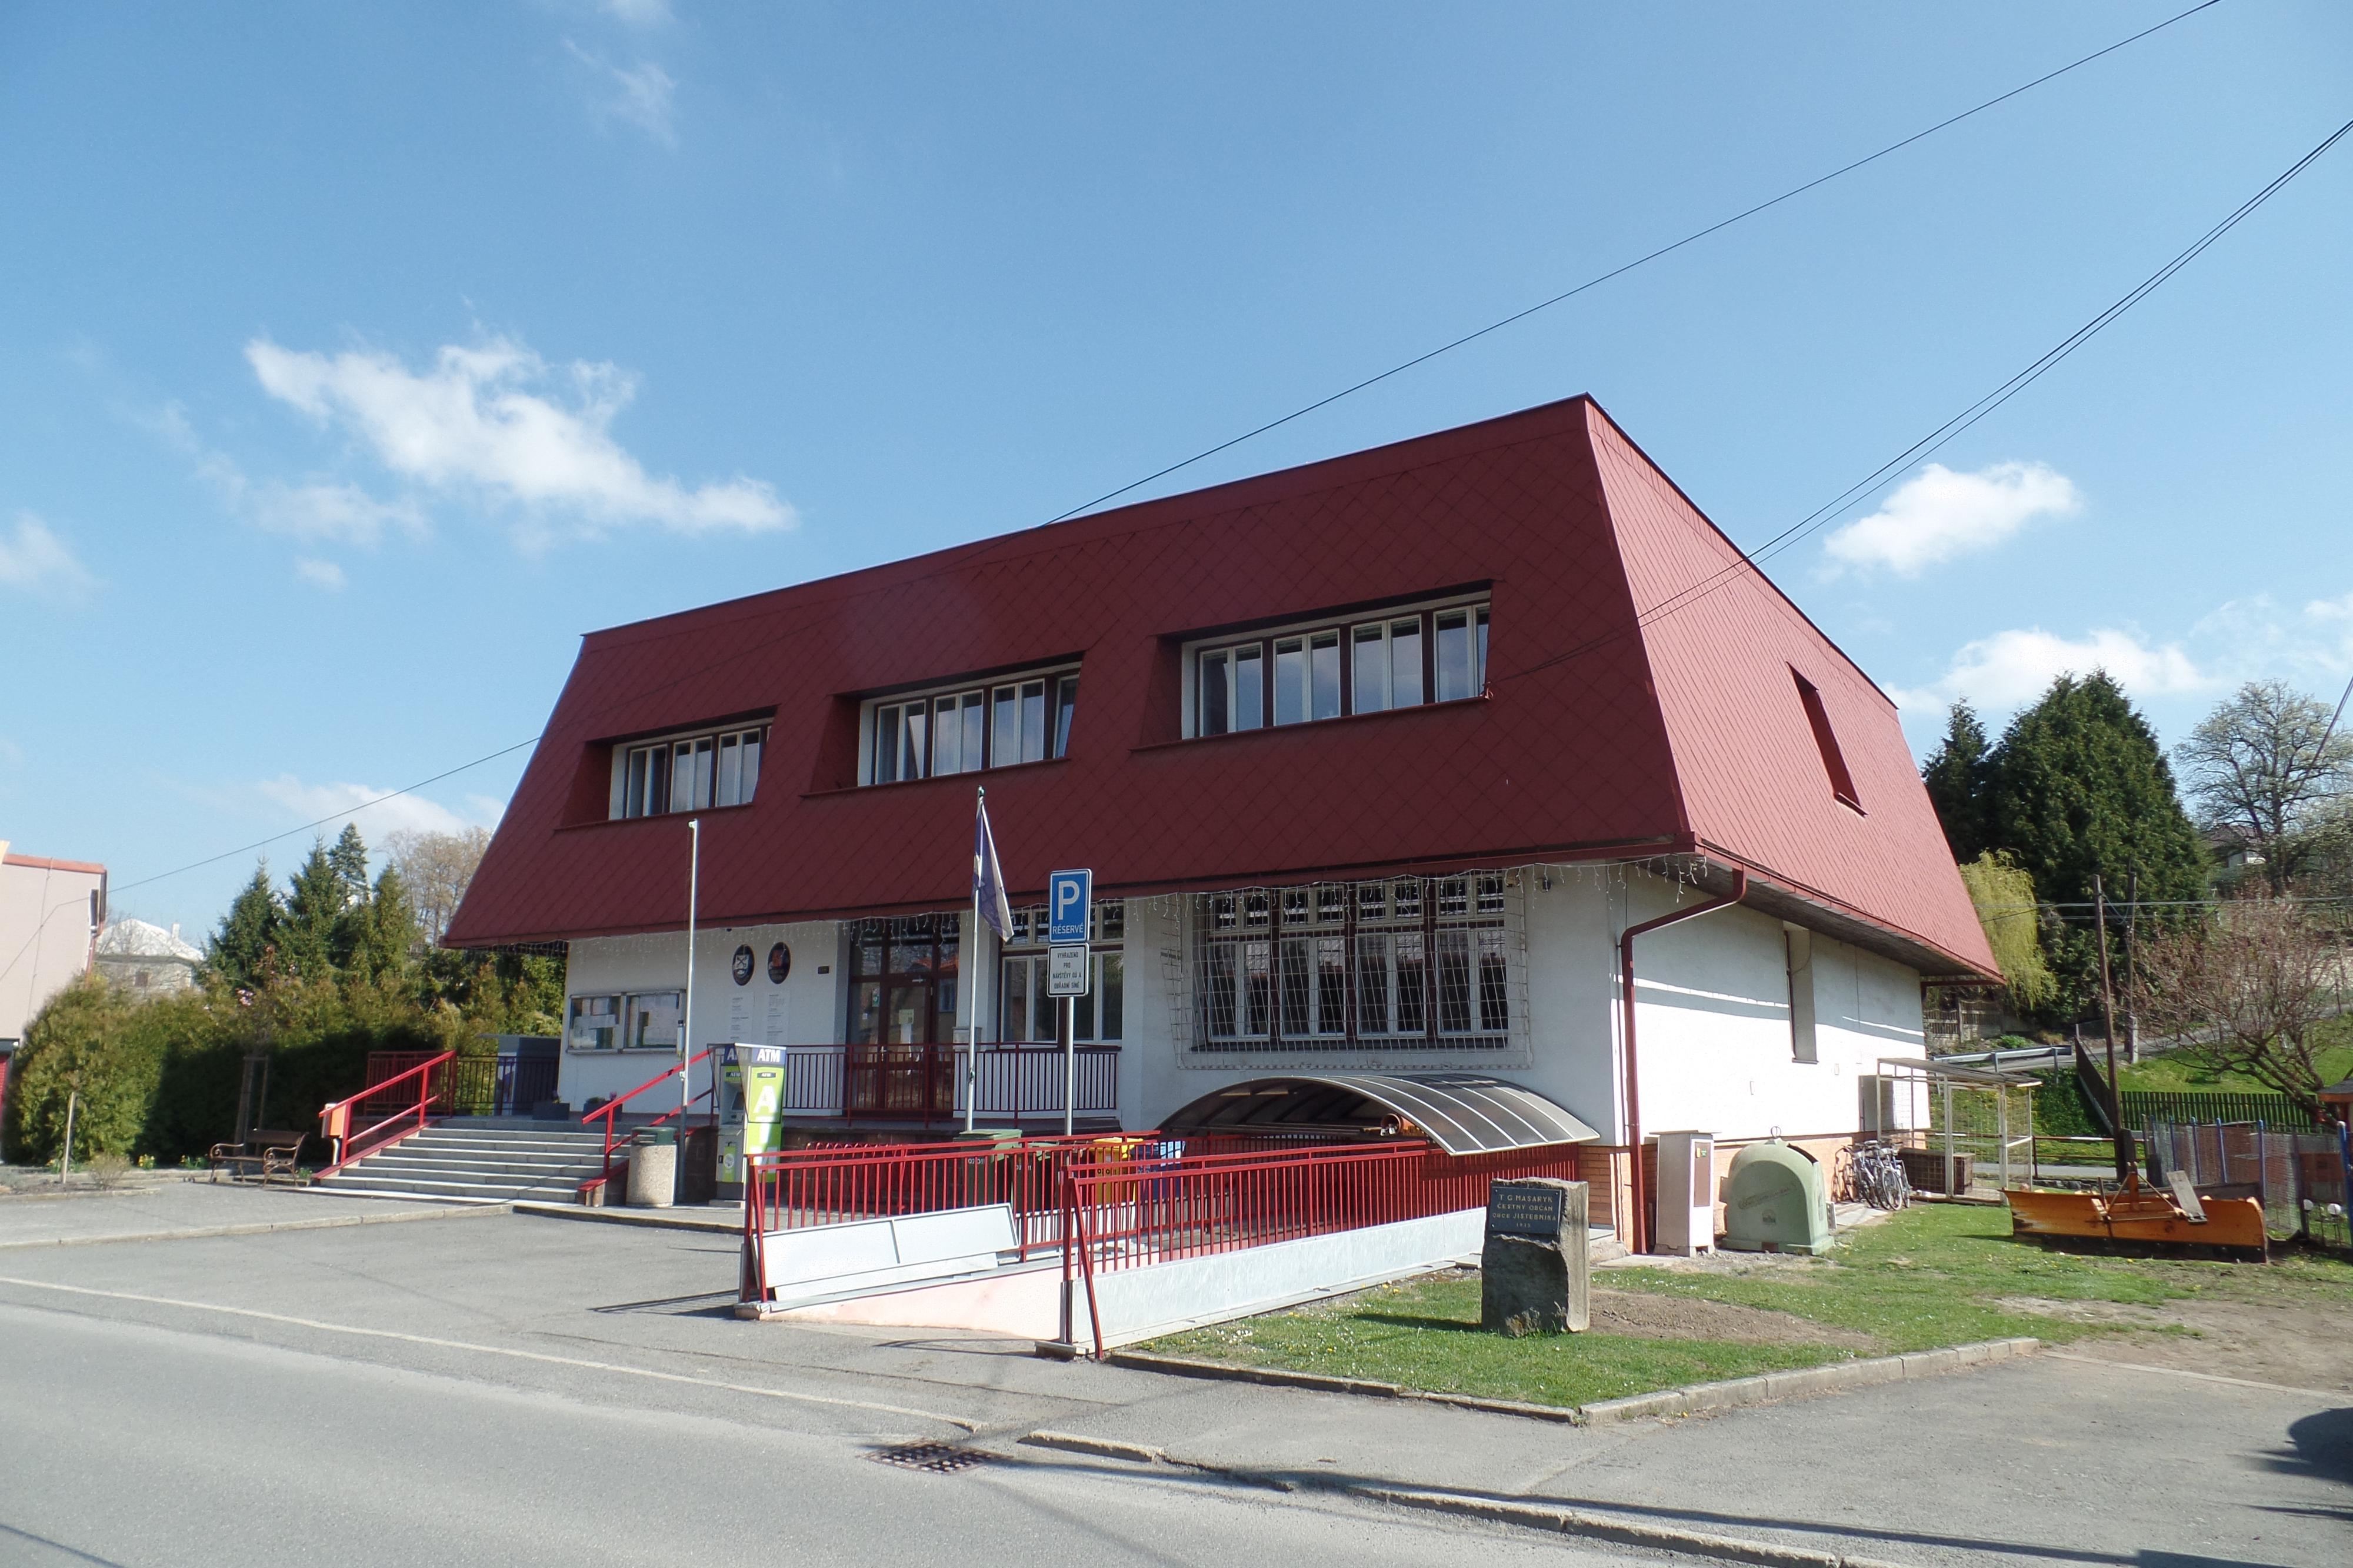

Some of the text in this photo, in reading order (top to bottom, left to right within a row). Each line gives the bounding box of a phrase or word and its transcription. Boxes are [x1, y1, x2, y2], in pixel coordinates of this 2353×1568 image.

[1058, 880, 1079, 920] P
[1052, 922, 1084, 935] RÉSERVÉ
[757, 1049, 781, 1062] ATM
